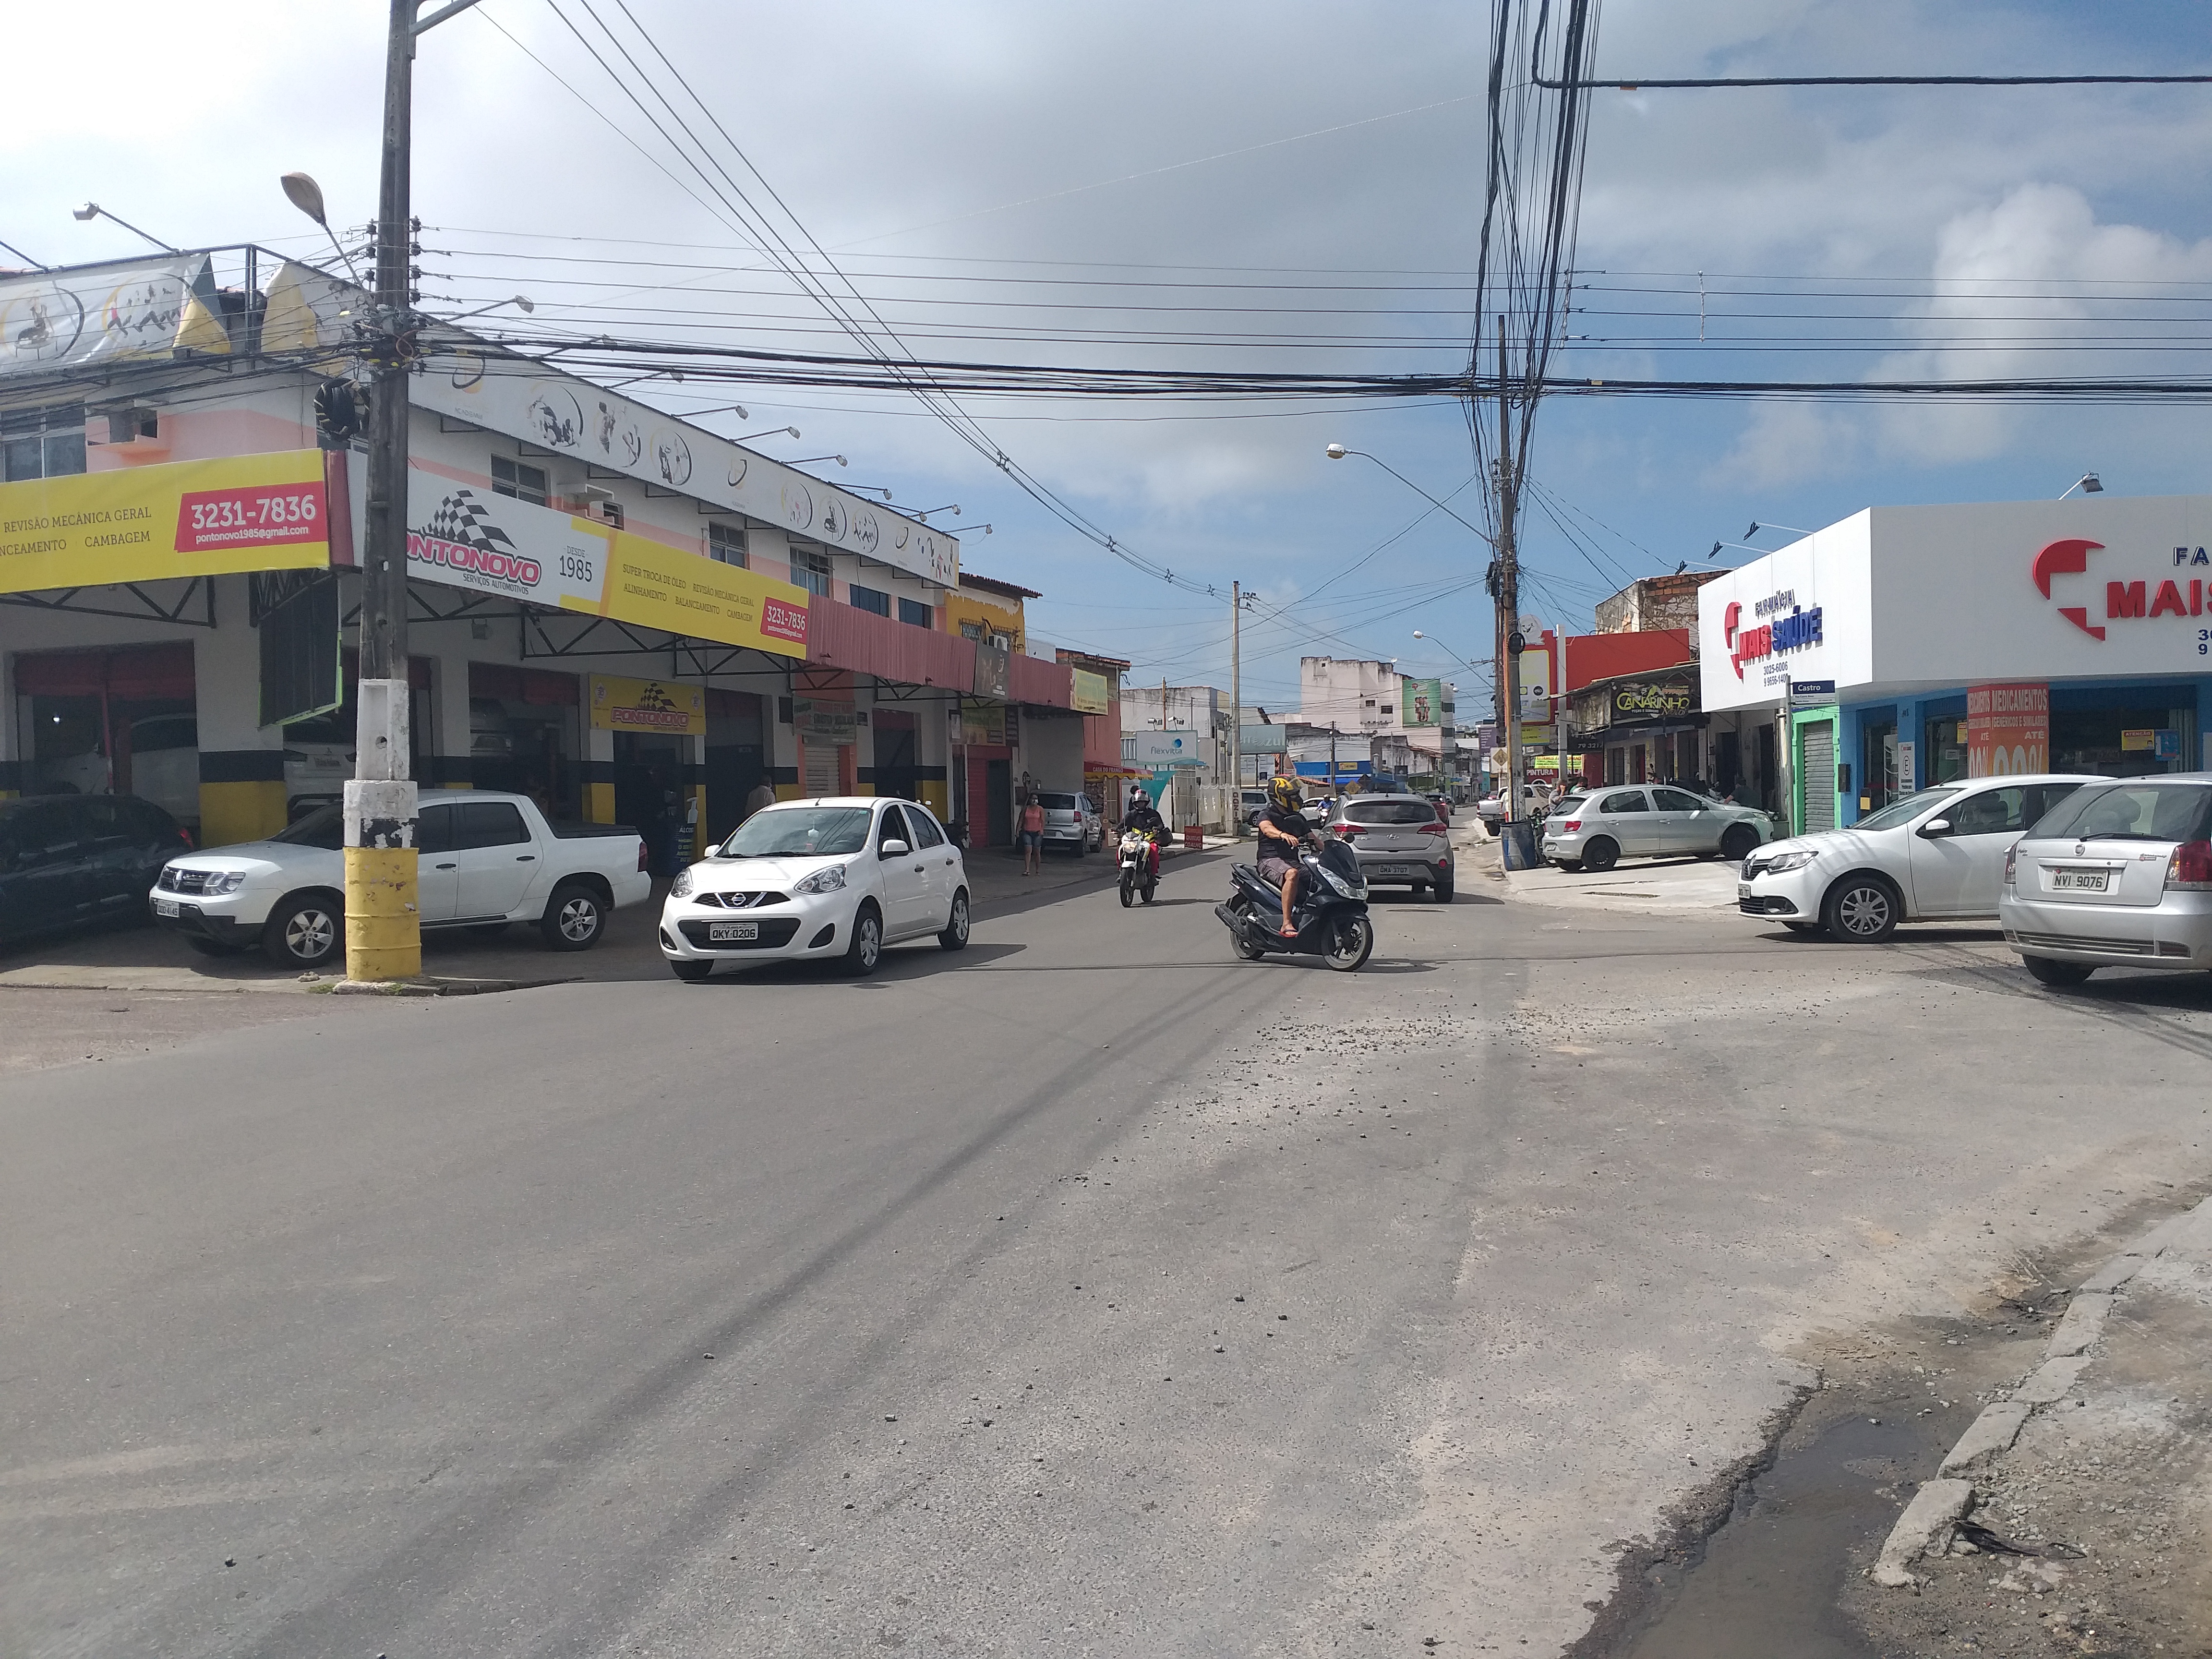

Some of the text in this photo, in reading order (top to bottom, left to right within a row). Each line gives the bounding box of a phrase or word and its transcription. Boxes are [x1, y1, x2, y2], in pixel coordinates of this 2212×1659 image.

[4, 506, 152, 533] REVISÃO MECÂNICA GERAL
[191, 494, 316, 529] 3231-7836
[84, 530, 151, 547] CAMBAGEM
[195, 526, 309, 545] pontonovo1985@gmail.com
[407, 533, 540, 583] NTONOVO
[566, 545, 586, 558] DESDE
[559, 554, 592, 582] 1985
[623, 564, 686, 589] SUPER TROCA DE ÓLEO
[463, 573, 529, 595] SERVIÇOS AUTOMOTIVOS
[624, 583, 753, 623] ALINHAMENTO BALANCEAMENTO CAMBAGEM
[693, 583, 755, 608] REVISÃO MECÂNICA GERAL
[1755, 589, 1795, 617] FARMÁCIA
[2107, 579, 2212, 618] MAI
[767, 605, 806, 631] 3231-7836
[1739, 605, 1823, 661] MAIS SAÚDE
[2198, 629, 2212, 641] 3
[1763, 661, 1788, 675] 3025-6006
[1764, 677, 1767, 687] 9
[1616, 692, 1690, 710] CANARINHO
[1992, 688, 2047, 711] MEDICAMENTOS
[611, 707, 689, 726] PONTONOVO
[1981, 731, 1989, 741] ATÉ
[2024, 729, 2044, 740] ATÉ
[1151, 746, 1183, 755] flexvitta
